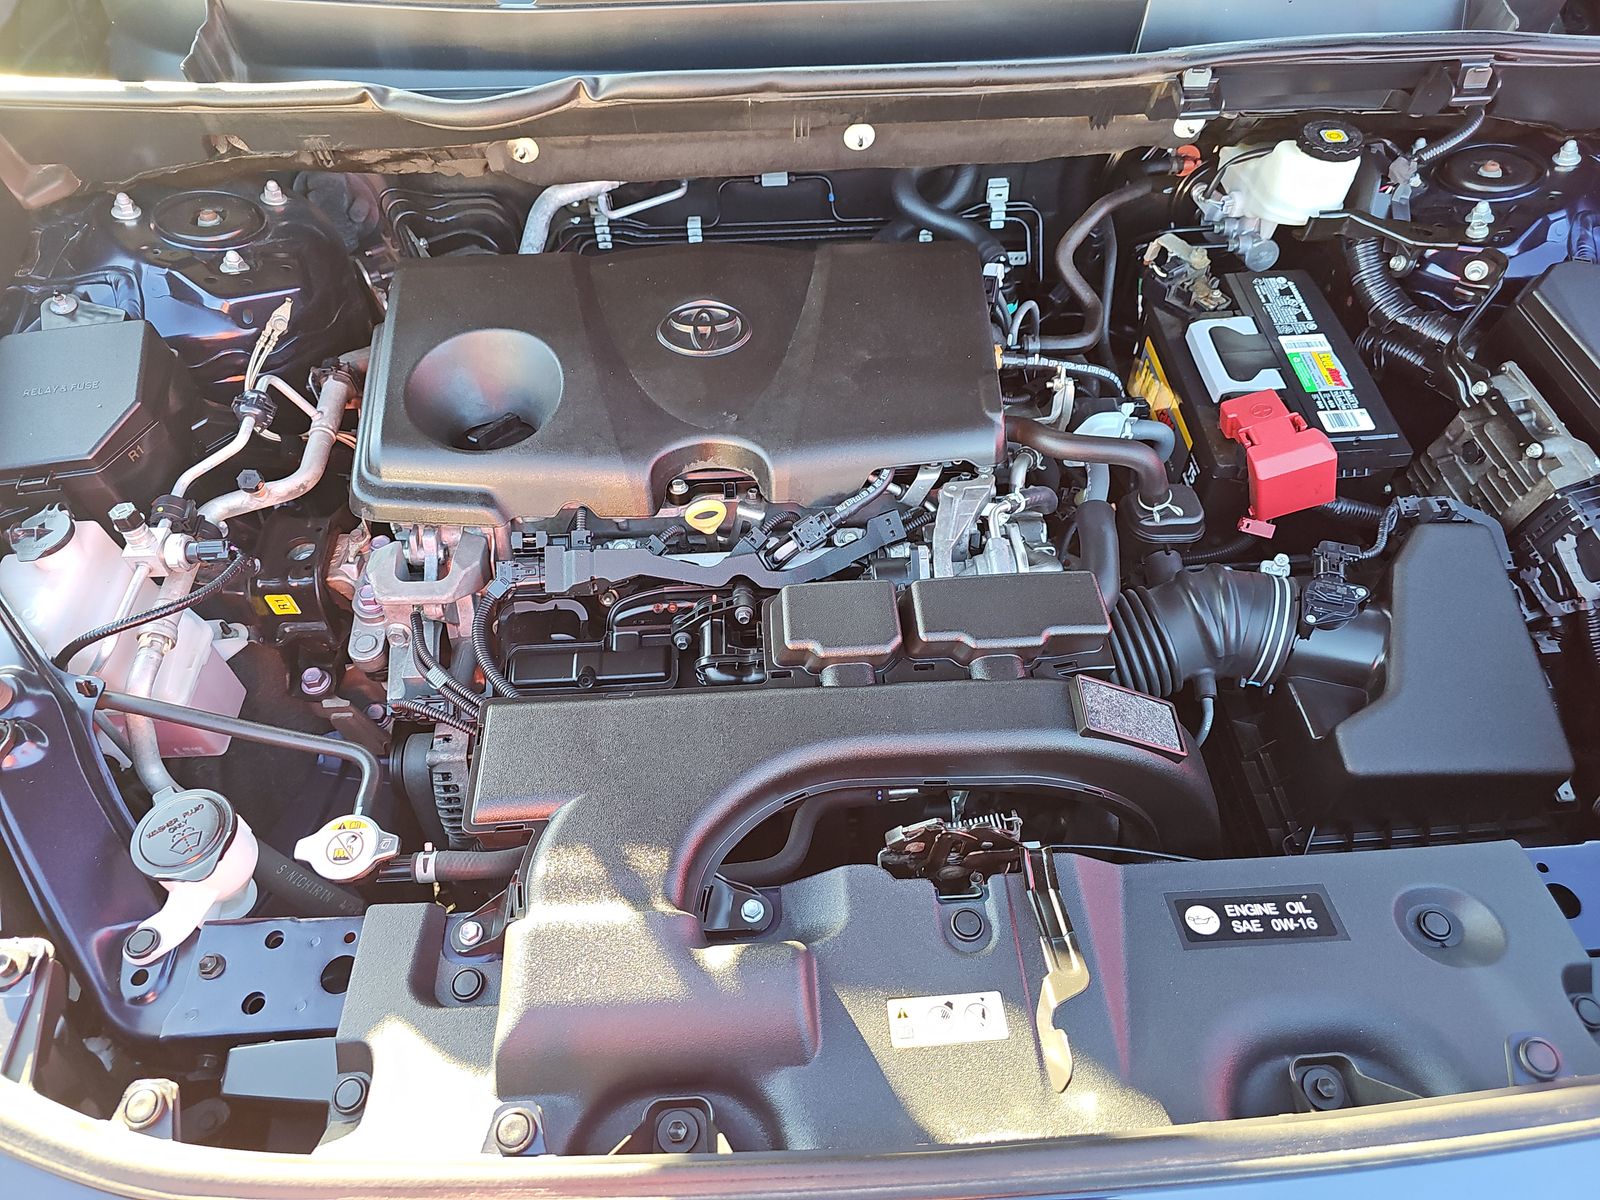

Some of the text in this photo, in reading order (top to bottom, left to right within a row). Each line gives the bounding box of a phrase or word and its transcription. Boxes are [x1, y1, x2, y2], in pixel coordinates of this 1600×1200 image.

[23, 384, 59, 397] RELAY
[70, 381, 101, 392] FUSE
[128, 445, 144, 462] R1
[147, 817, 180, 839] WASHER
[168, 819, 188, 833] ONLY
[1224, 901, 1312, 917] ENGINE OIL
[1231, 917, 1318, 933] SAE 0W-16
